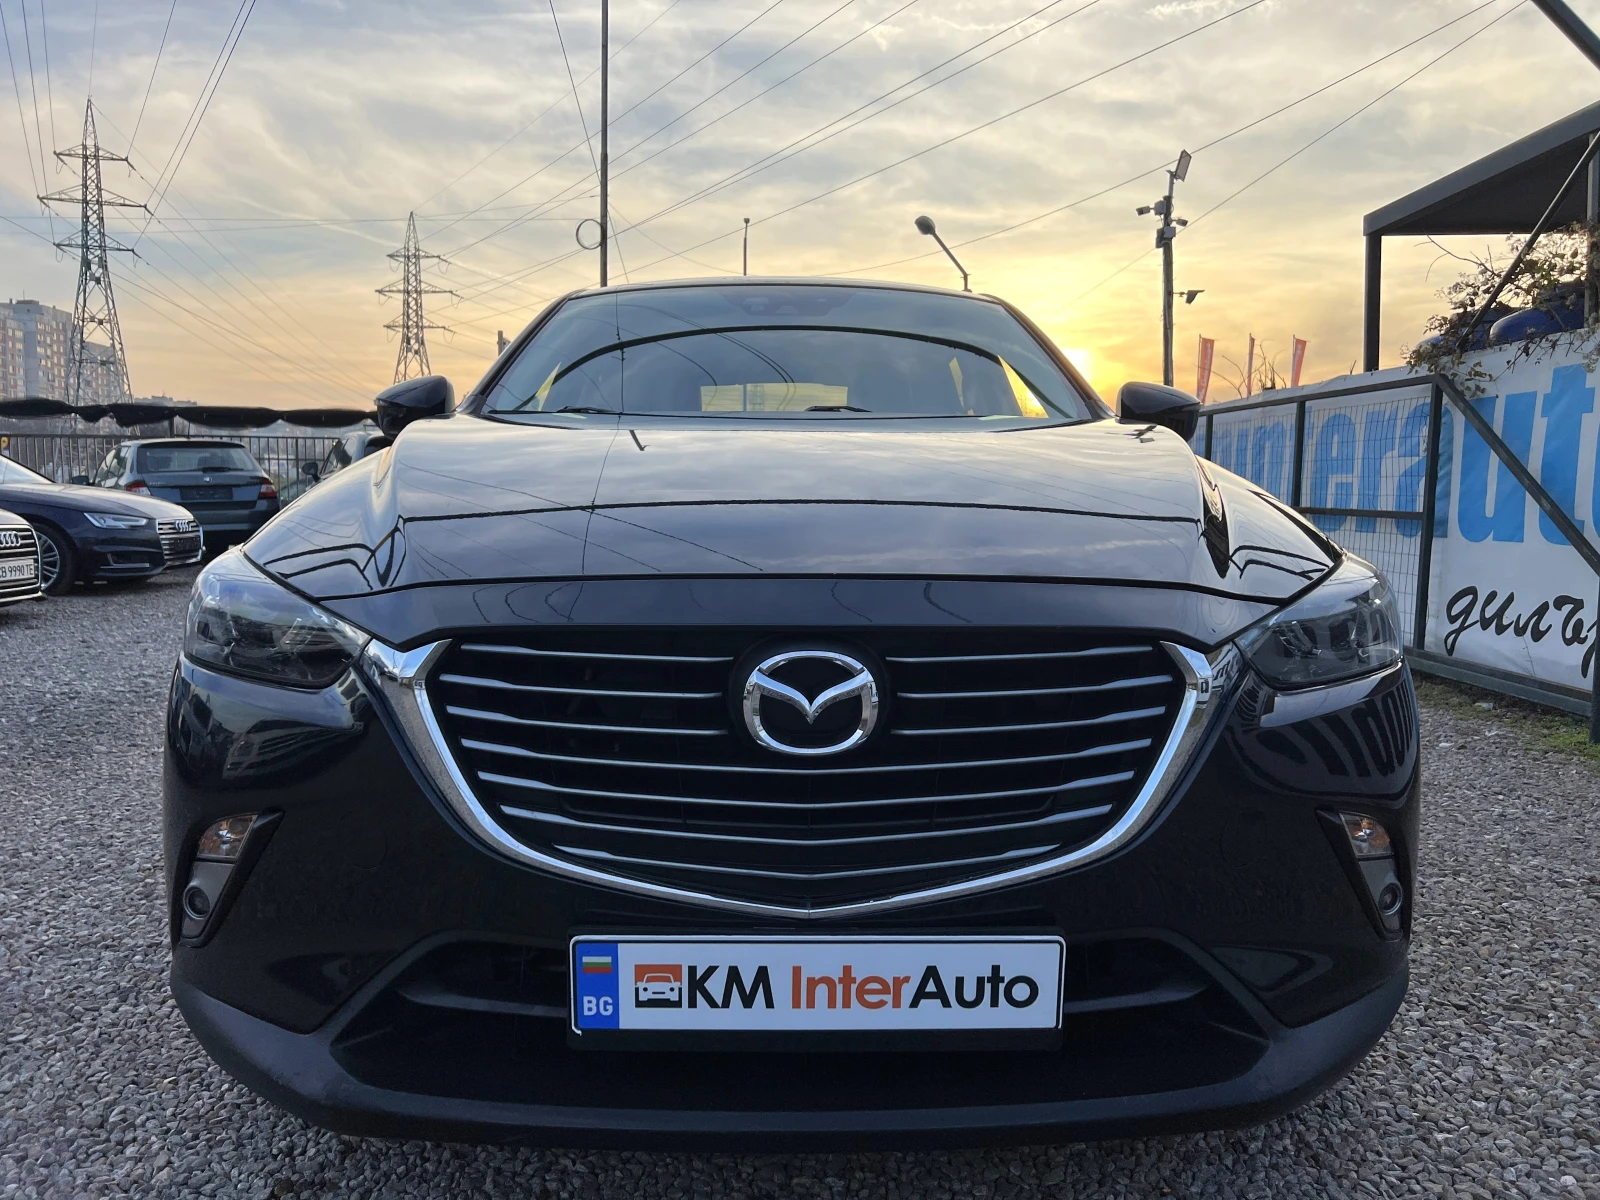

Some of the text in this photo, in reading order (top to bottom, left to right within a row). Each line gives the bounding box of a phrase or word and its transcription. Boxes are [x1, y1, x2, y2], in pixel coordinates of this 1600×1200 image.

[8, 564, 25, 577] 9990
[25, 563, 34, 576] TE
[687, 964, 1040, 1010] KM InterAuto
[582, 995, 614, 1016] BG
